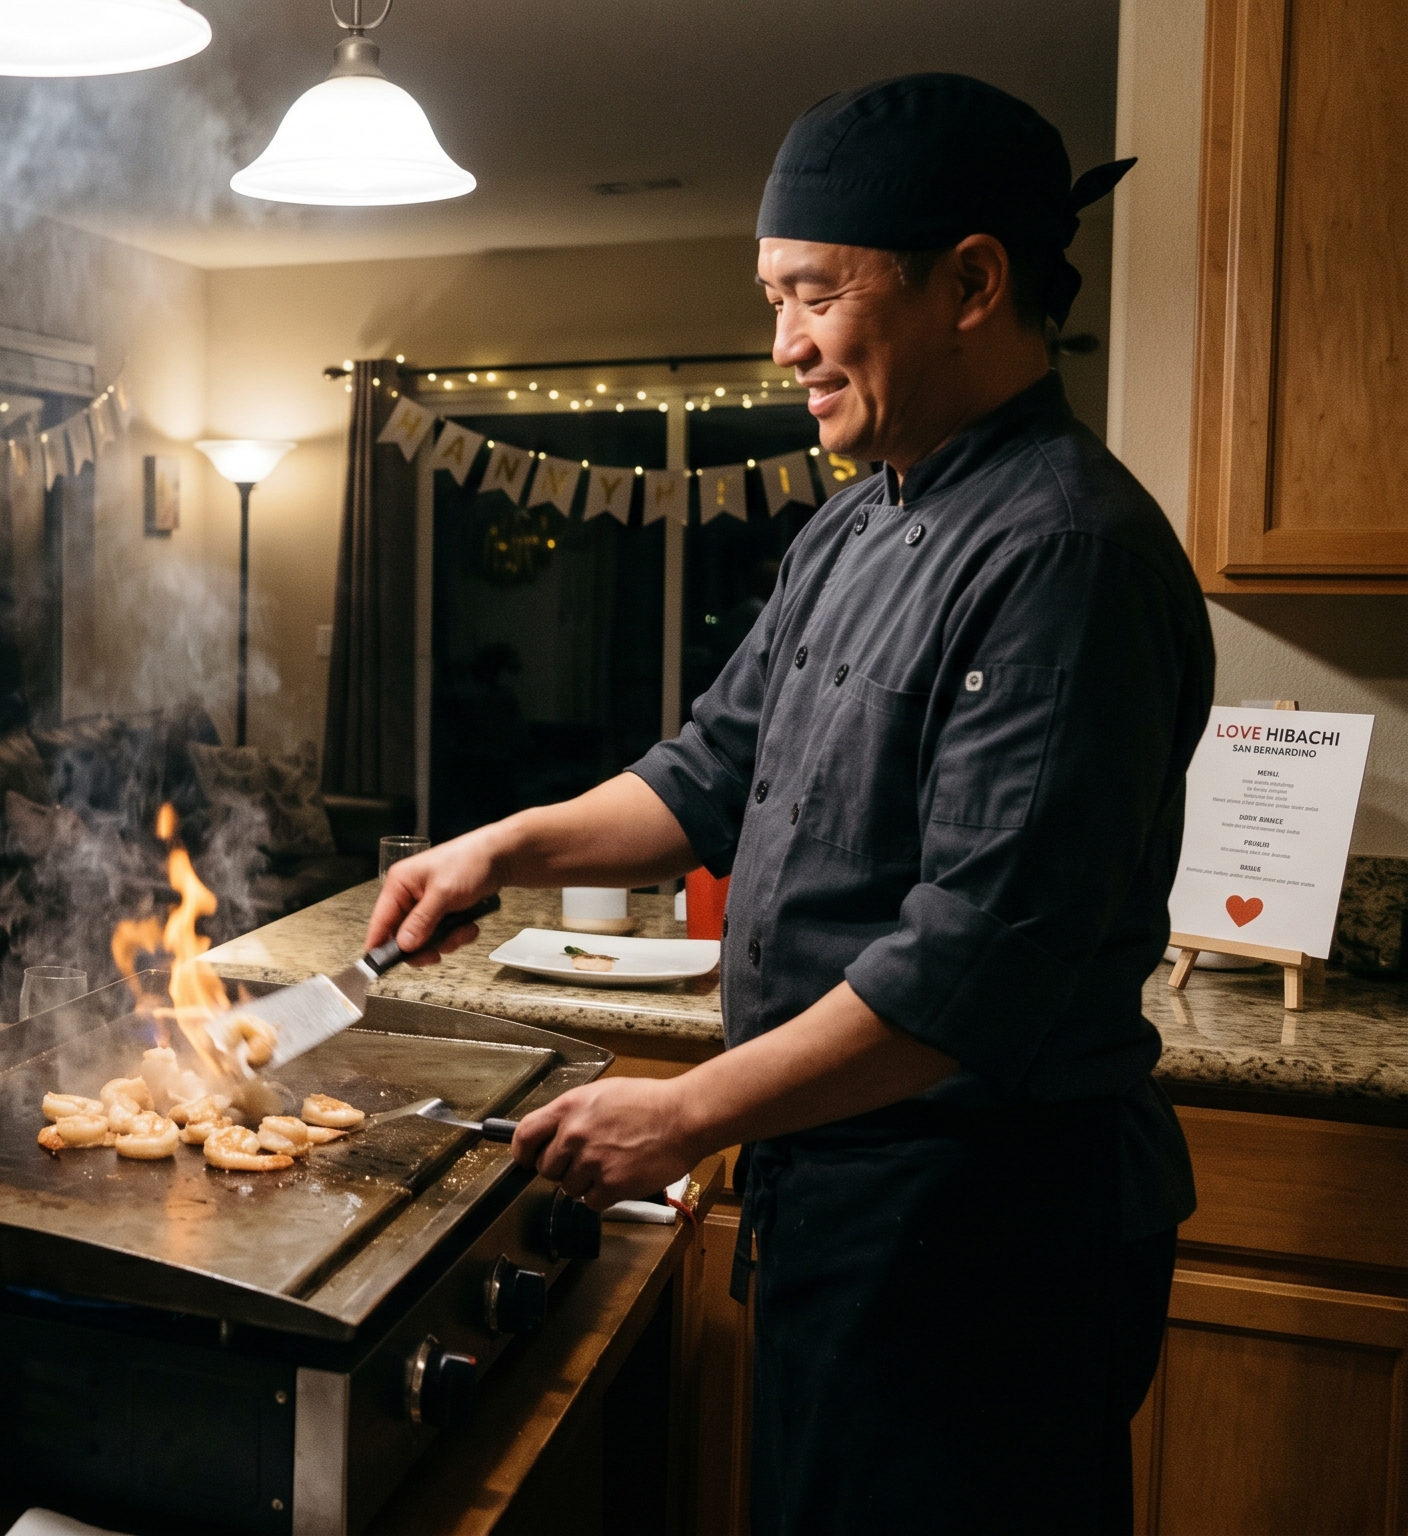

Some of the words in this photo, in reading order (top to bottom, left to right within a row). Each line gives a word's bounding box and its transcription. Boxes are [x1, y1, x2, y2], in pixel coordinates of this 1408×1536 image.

[1216, 723, 1263, 741] LOVE
[1266, 727, 1340, 747] HIBACHI
[1232, 744, 1252, 754] SAN
[1253, 746, 1317, 758] BERNARDINO
